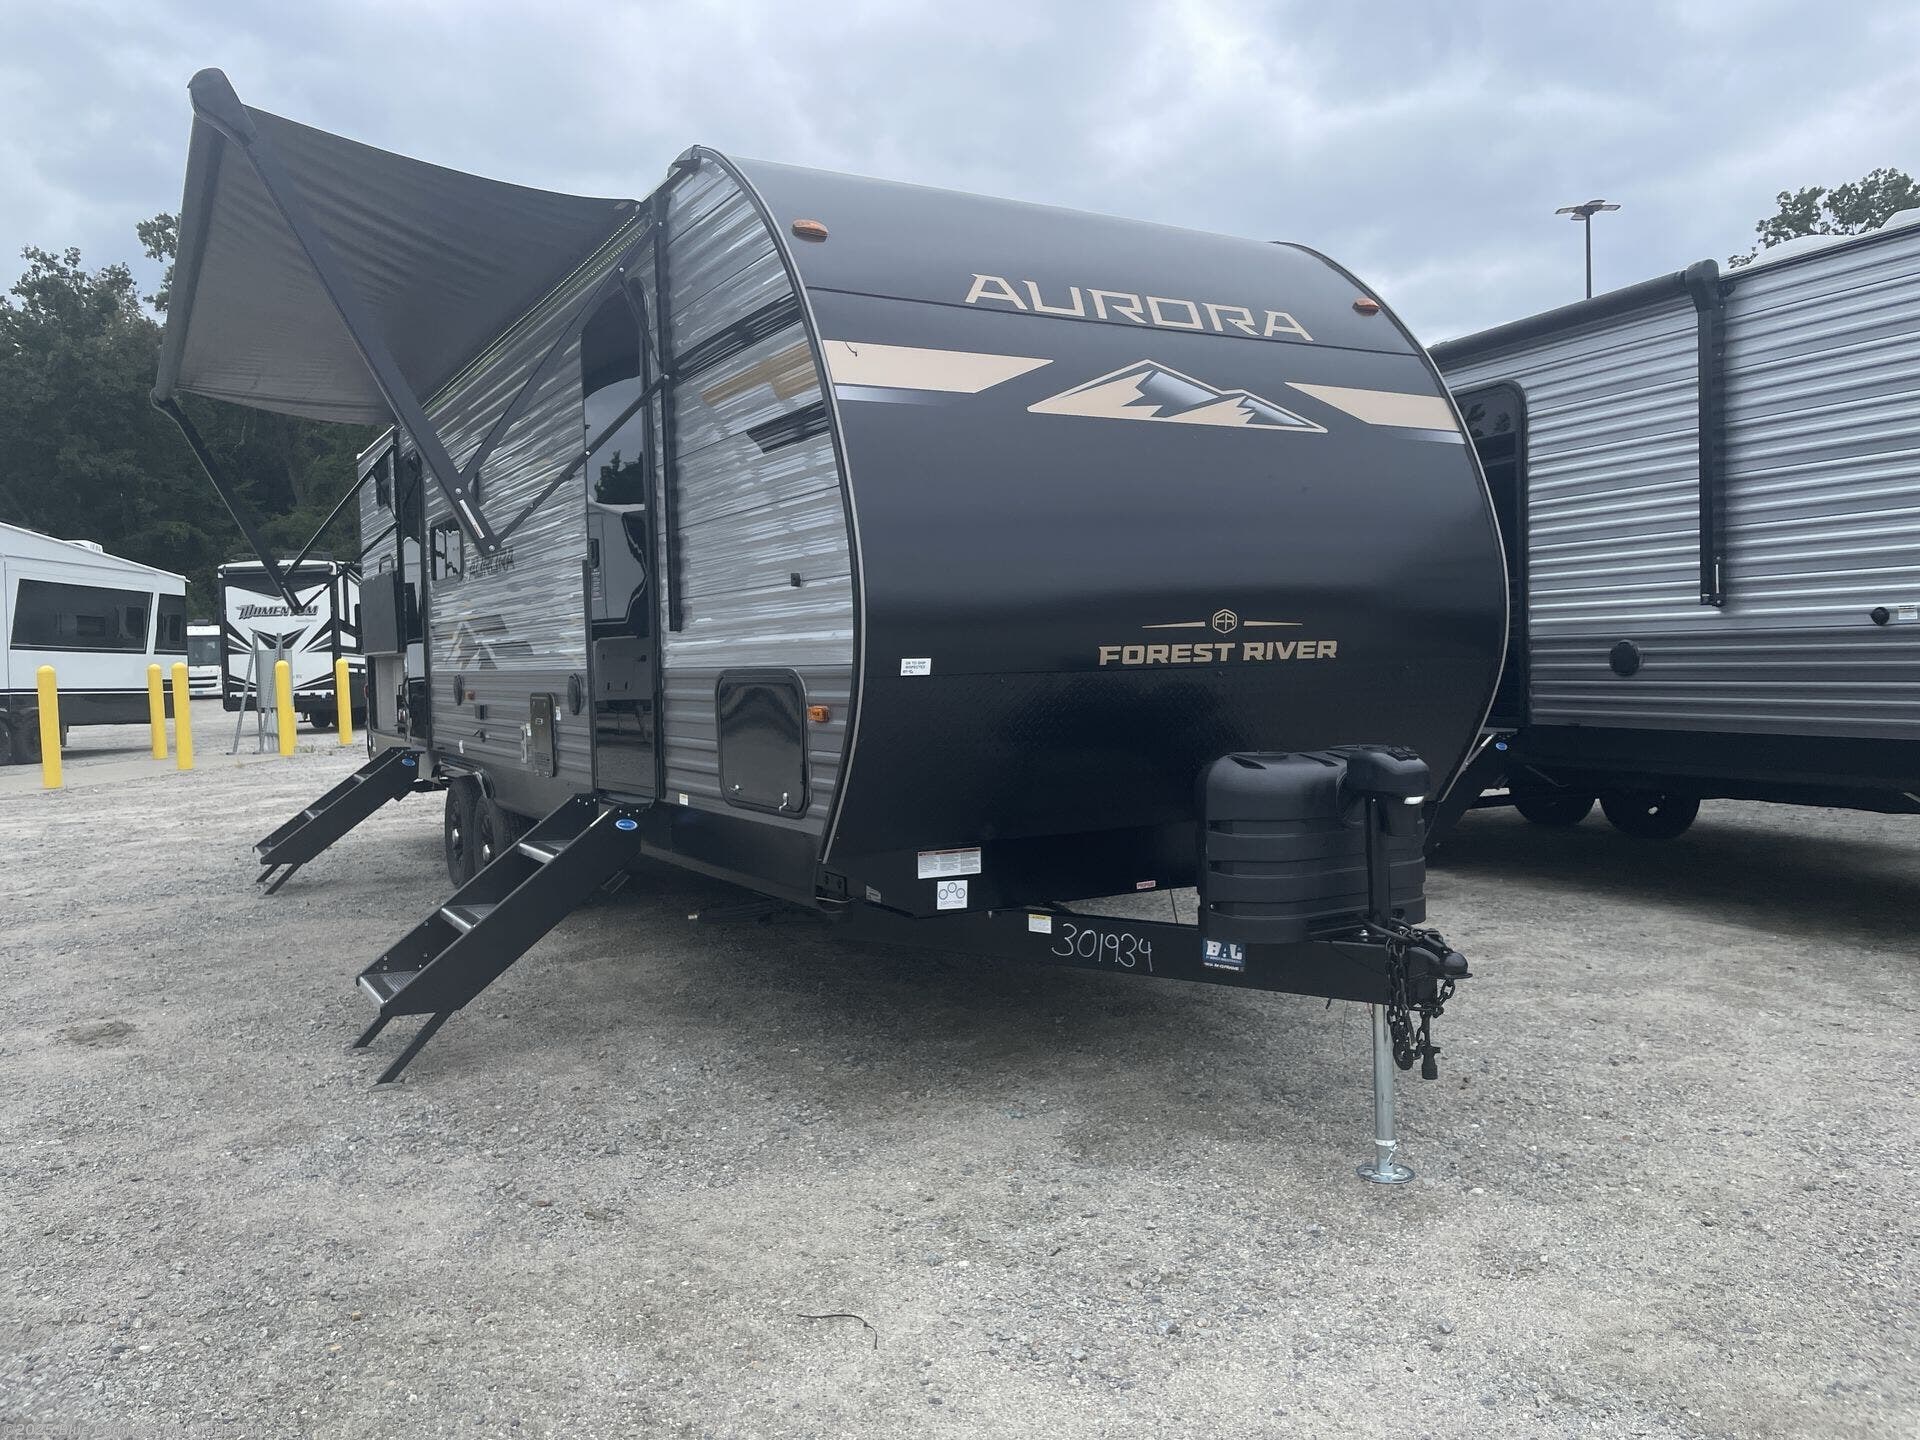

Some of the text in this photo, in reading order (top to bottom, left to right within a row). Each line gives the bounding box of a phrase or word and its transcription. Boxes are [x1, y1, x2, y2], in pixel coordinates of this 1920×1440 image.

[965, 273, 1314, 341] AURORA
[236, 604, 318, 619] MOMENM
[1099, 640, 1338, 666] FOREST RIVER
[1051, 923, 1153, 972] 301934
